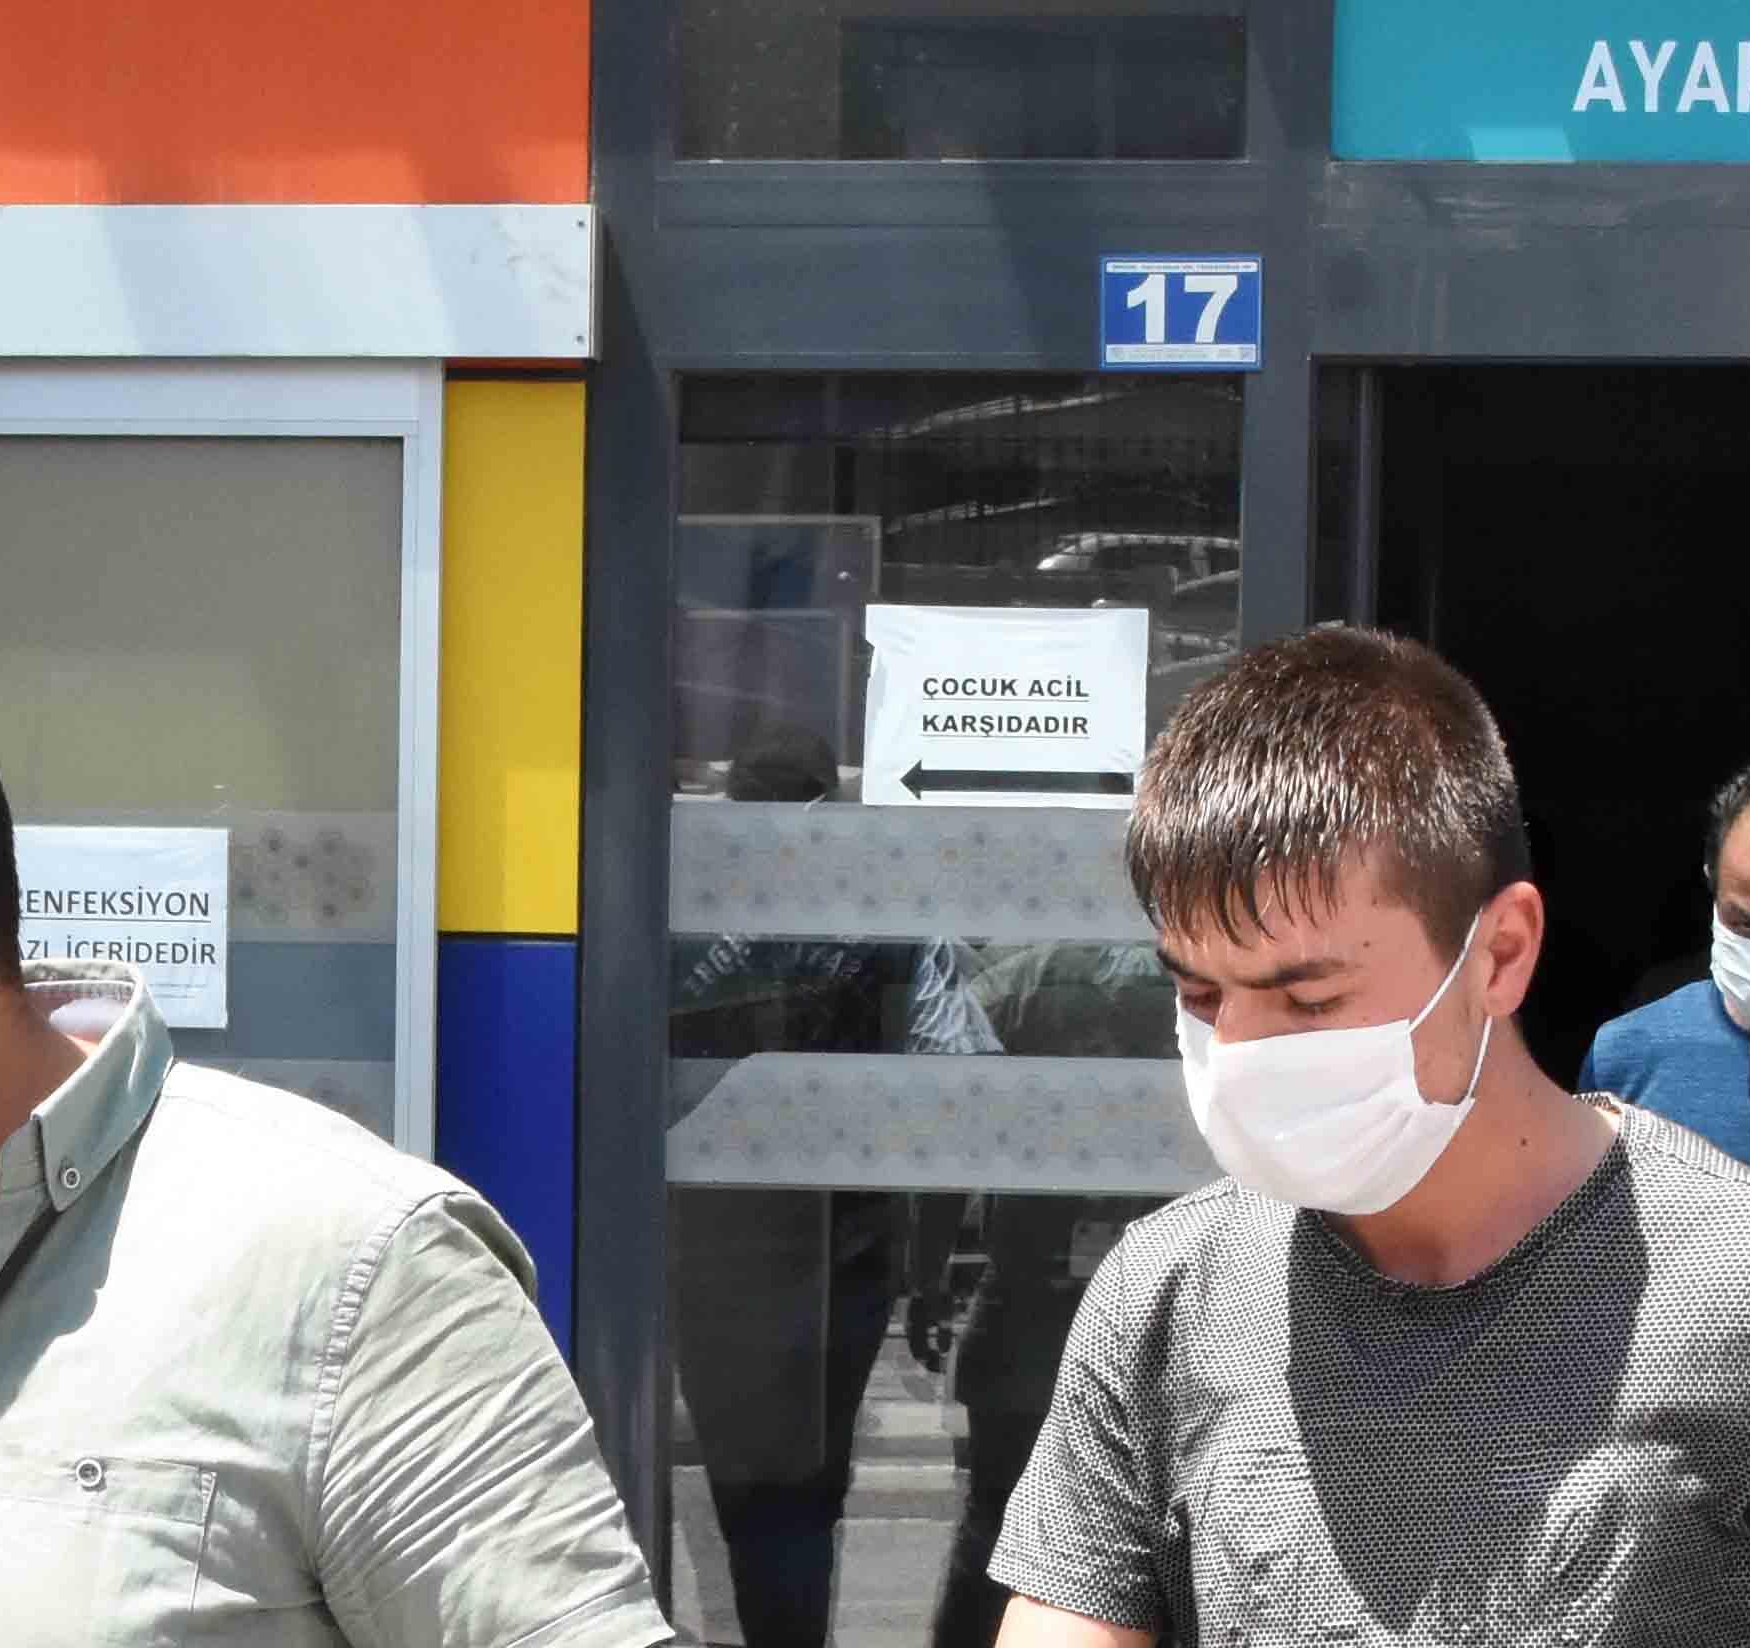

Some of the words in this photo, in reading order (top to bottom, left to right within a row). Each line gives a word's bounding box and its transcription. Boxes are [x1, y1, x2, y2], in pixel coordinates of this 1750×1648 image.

[1127, 274, 1239, 343] 17
[923, 678, 1019, 699] ÇOCUK
[1028, 675, 1090, 698] ACİL
[922, 714, 1090, 737] KARŞIDADIR
[19, 886, 210, 917] ENFEKSİYON
